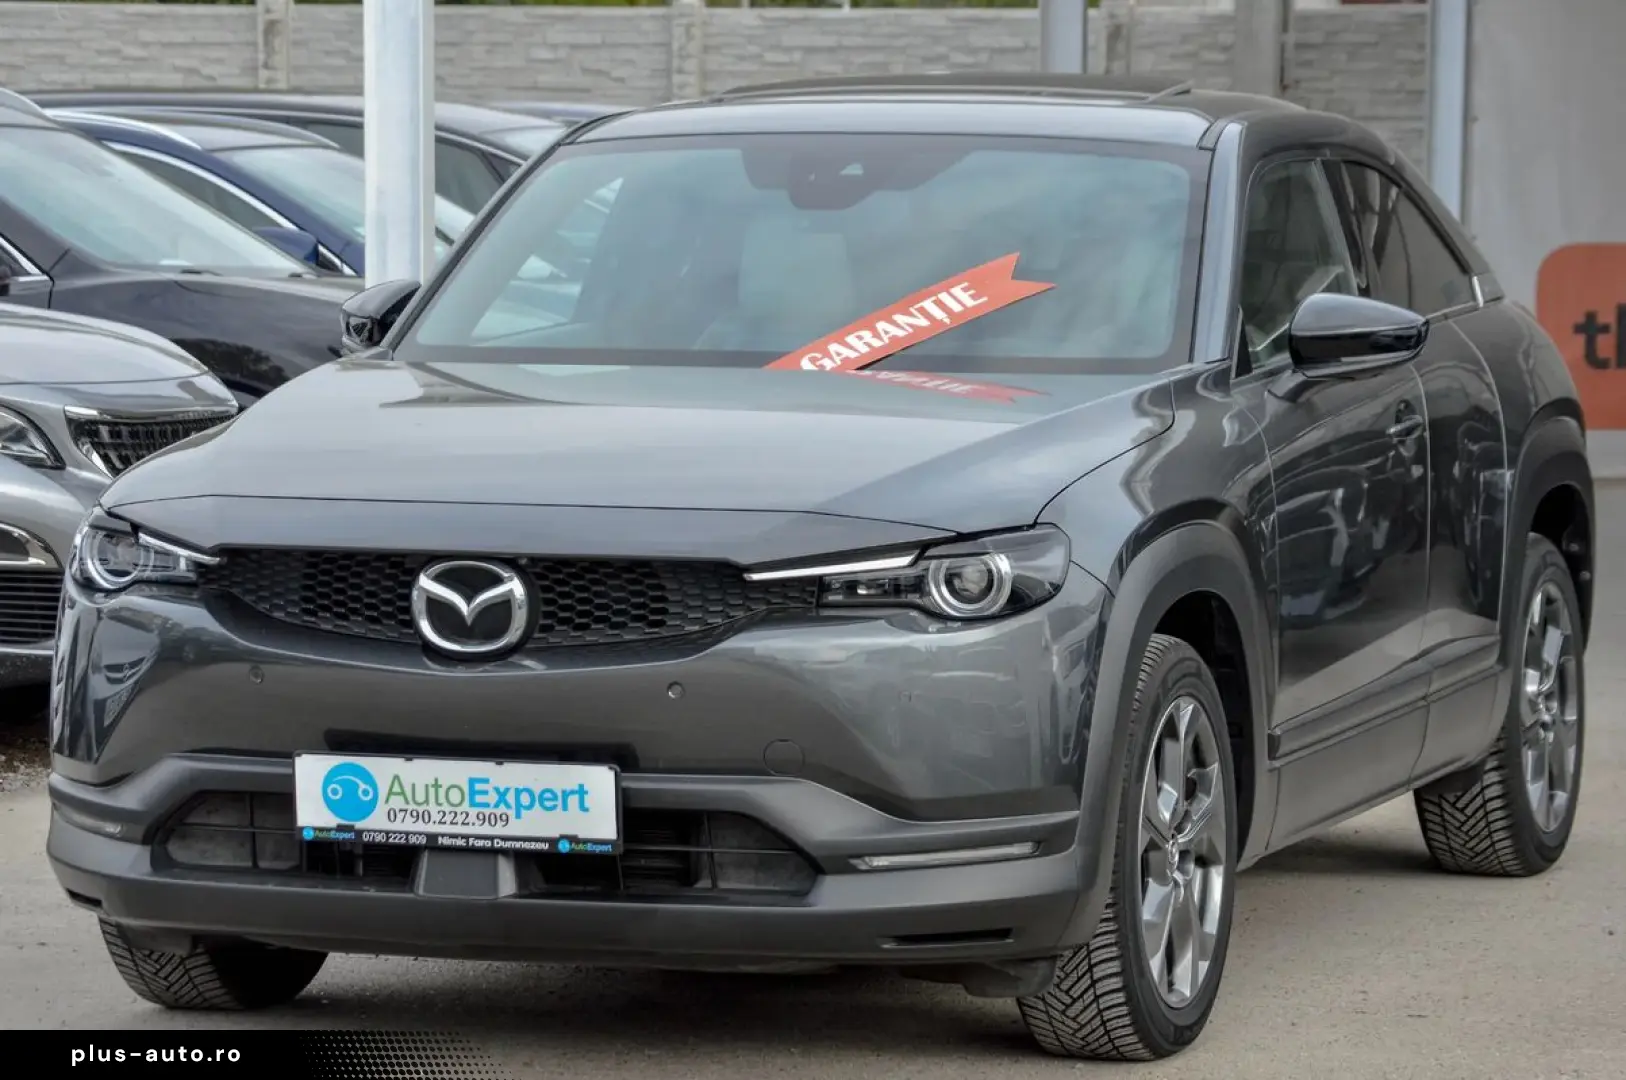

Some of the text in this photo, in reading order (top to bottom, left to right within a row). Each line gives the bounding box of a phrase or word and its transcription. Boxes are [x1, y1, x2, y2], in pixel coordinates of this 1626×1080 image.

[384, 774, 590, 819] AutoExpert
[387, 807, 510, 827] 0790.222.909
[314, 829, 355, 840] AutoExpert
[362, 831, 427, 845] 0790 222 909
[437, 836, 467, 846] Nimic
[493, 838, 549, 850] Dumnezeu
[571, 842, 612, 853] AutoExpert
